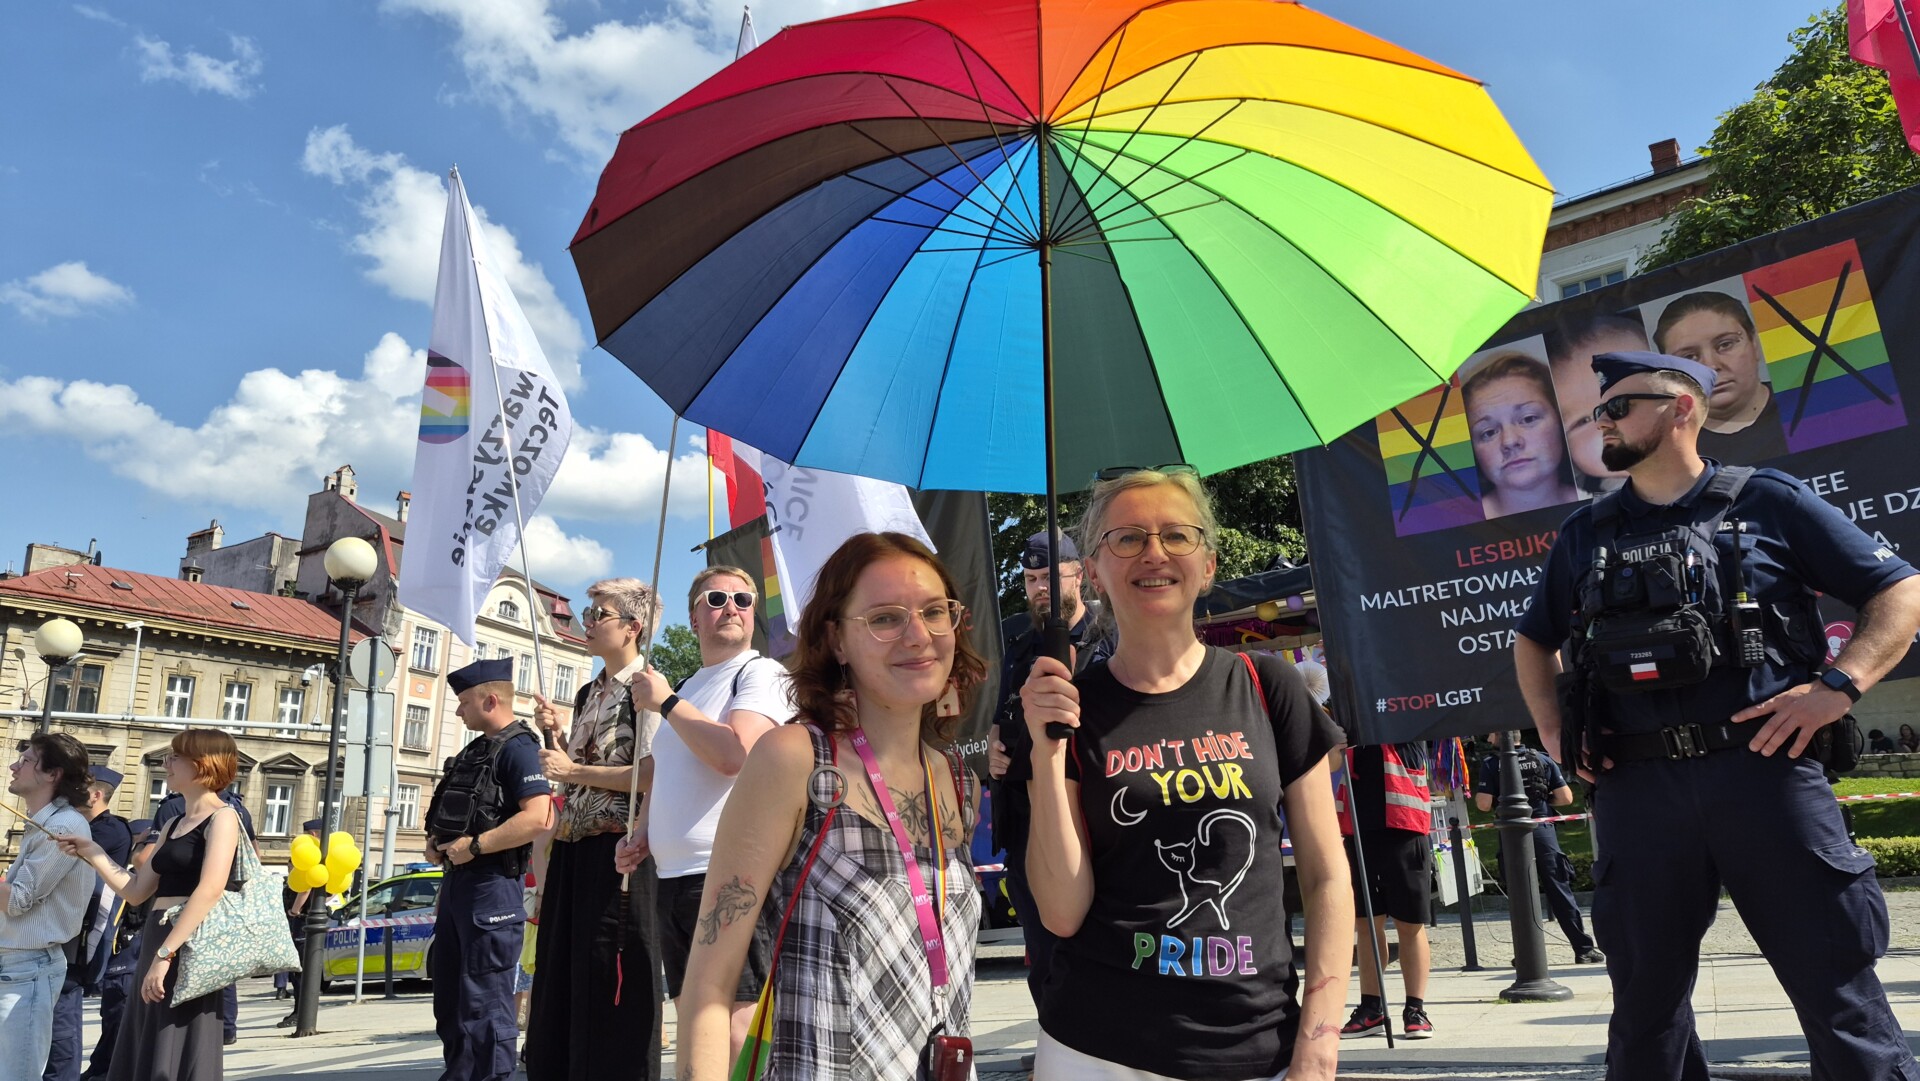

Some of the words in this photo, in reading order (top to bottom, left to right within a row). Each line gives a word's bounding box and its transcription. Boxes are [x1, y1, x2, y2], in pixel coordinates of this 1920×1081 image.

[1801, 470, 1849, 496] EE
[1833, 499, 1878, 523] JE
[1376, 687, 1483, 713] #STOPLGBT
[1106, 738, 1184, 778] DON'T
[1150, 762, 1253, 806] YOUR
[1131, 932, 1258, 976] PRIDE
